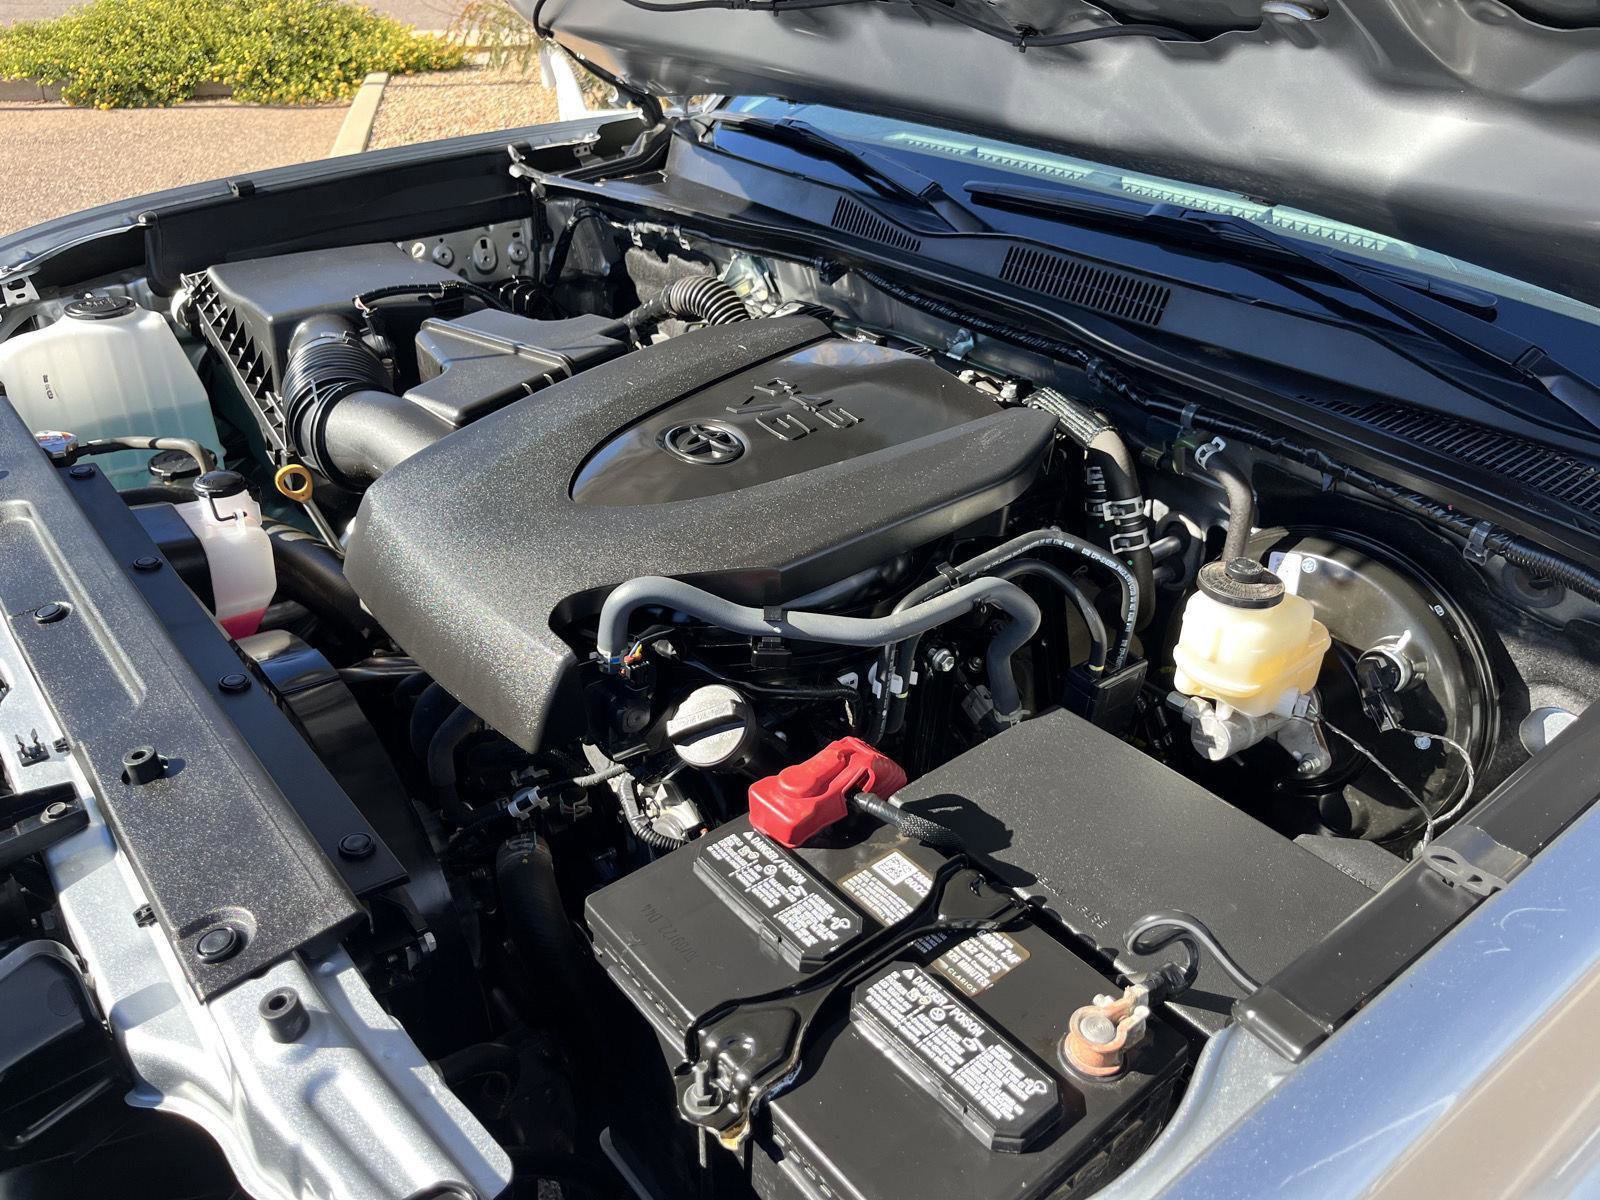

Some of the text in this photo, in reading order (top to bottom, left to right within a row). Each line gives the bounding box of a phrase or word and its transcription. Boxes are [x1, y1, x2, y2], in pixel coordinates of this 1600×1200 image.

[974, 951, 1001, 974] AMPS
[976, 929, 1007, 952] GROUP
[1000, 948, 1022, 964] 24F
[945, 948, 990, 987] 125 MINUTES
